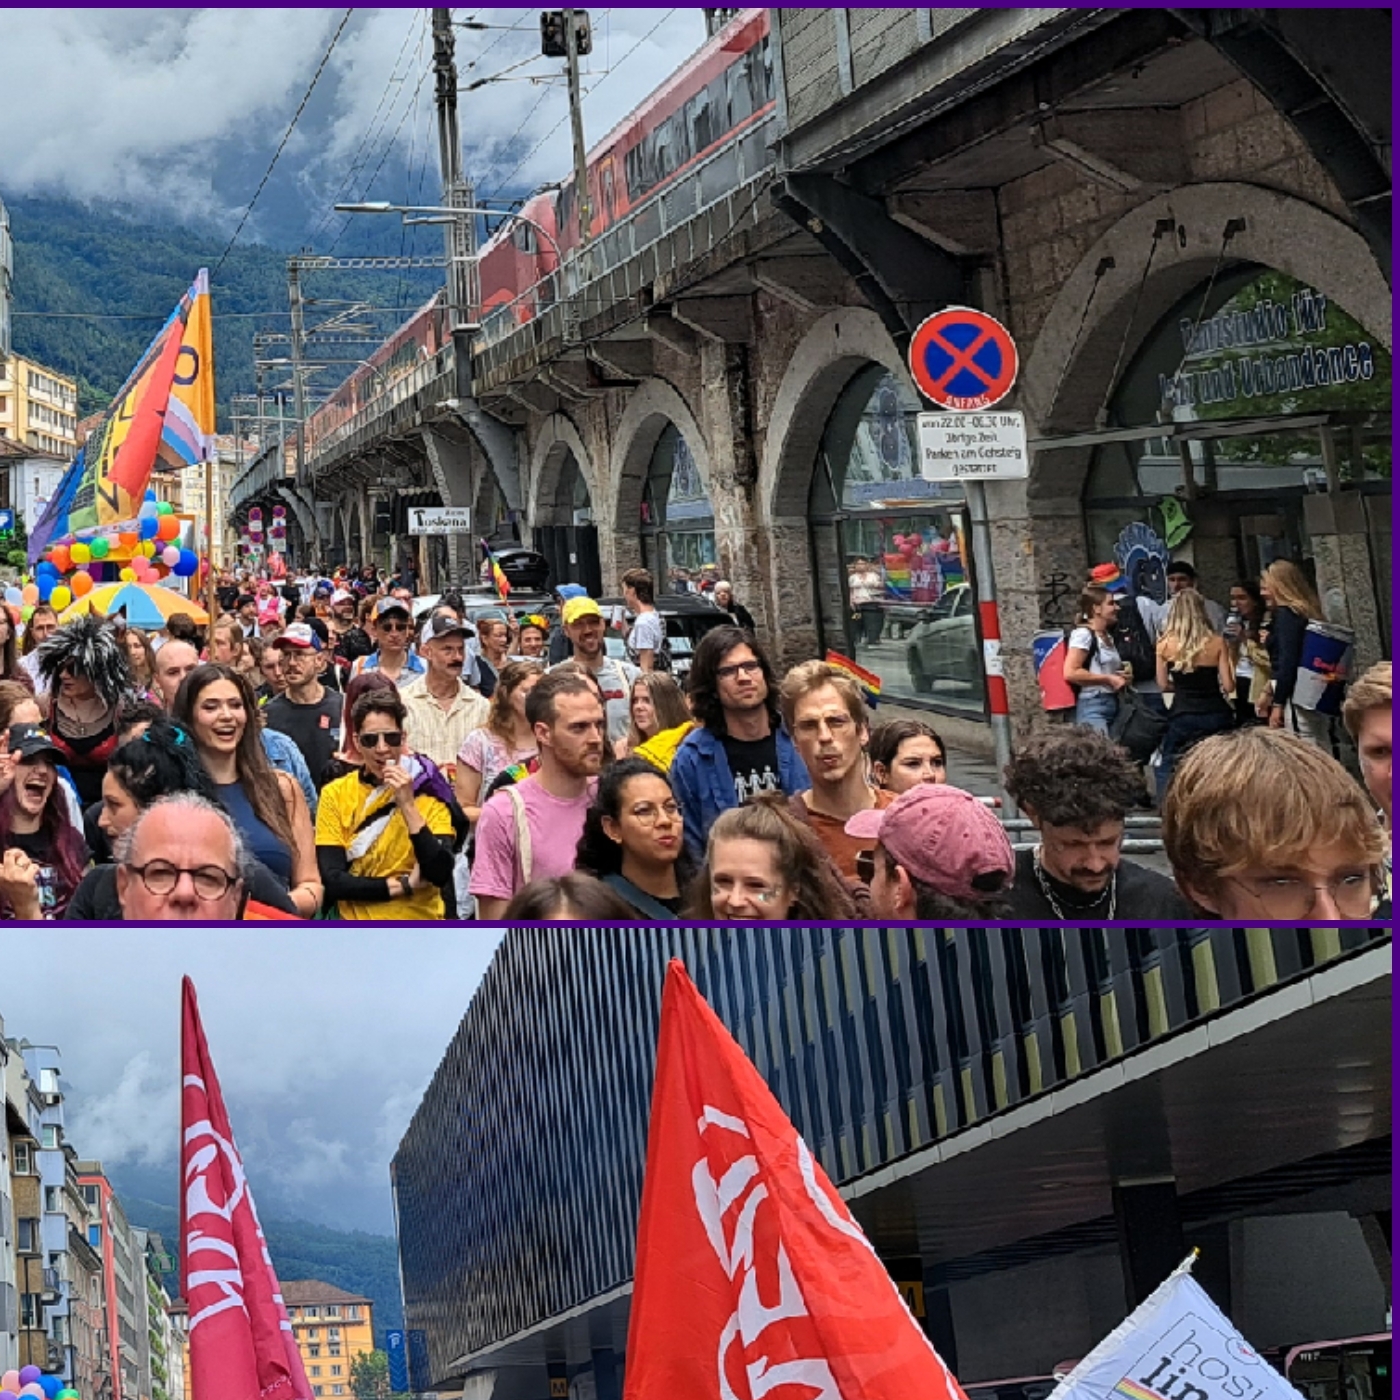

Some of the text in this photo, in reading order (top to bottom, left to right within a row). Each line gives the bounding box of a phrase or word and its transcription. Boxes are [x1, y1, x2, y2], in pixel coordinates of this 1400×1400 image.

[1292, 287, 1328, 336] für
[1199, 360, 1238, 405] und
[1238, 341, 1375, 399] Urbandance
[926, 447, 959, 460] Parken
[414, 509, 467, 526] Toskana
